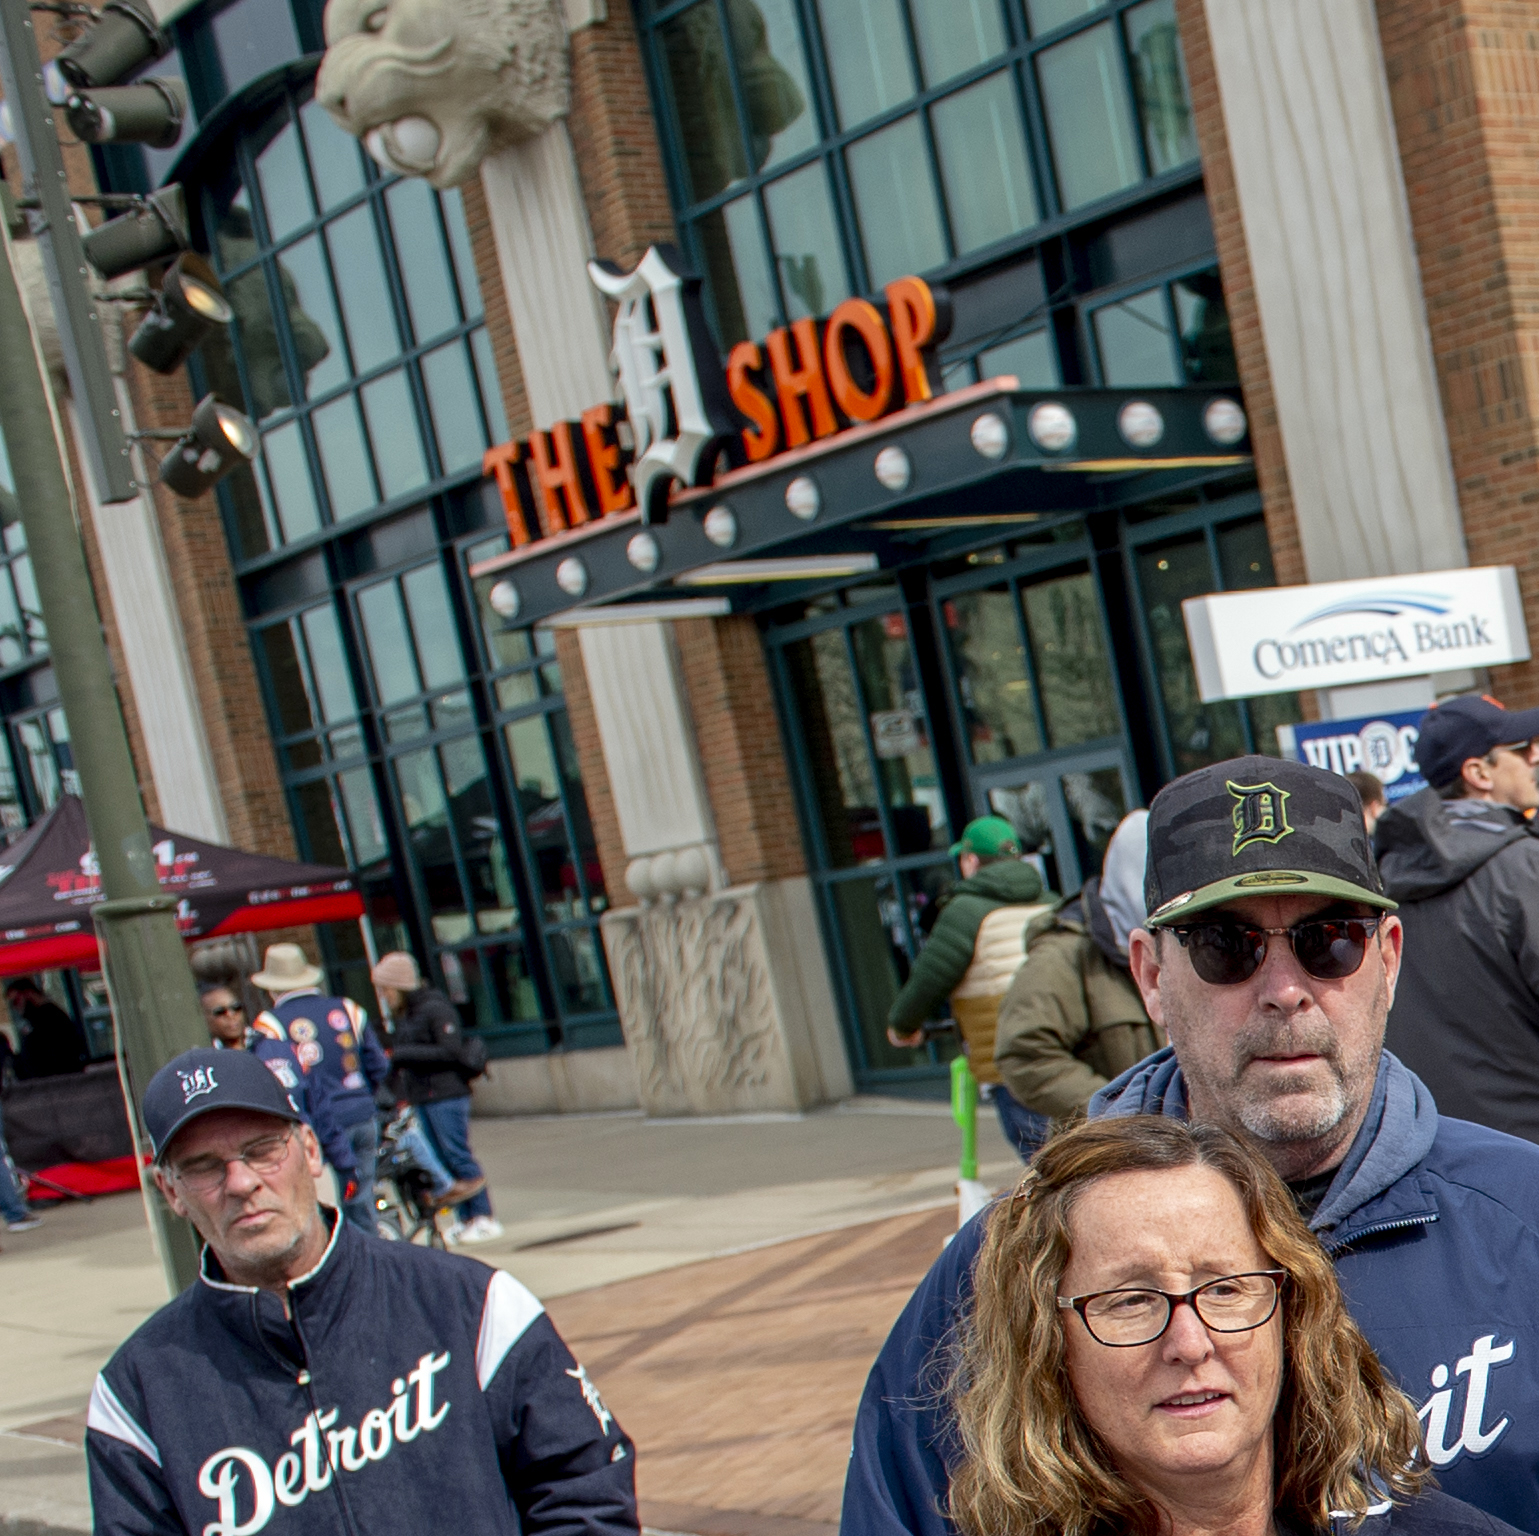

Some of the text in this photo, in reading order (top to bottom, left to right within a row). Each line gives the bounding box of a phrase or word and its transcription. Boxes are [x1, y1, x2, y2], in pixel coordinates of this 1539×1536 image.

[483, 404, 631, 547] THE
[726, 276, 936, 462] SHOP
[1414, 613, 1493, 654] Bank
[1302, 733, 1364, 776] VIP
